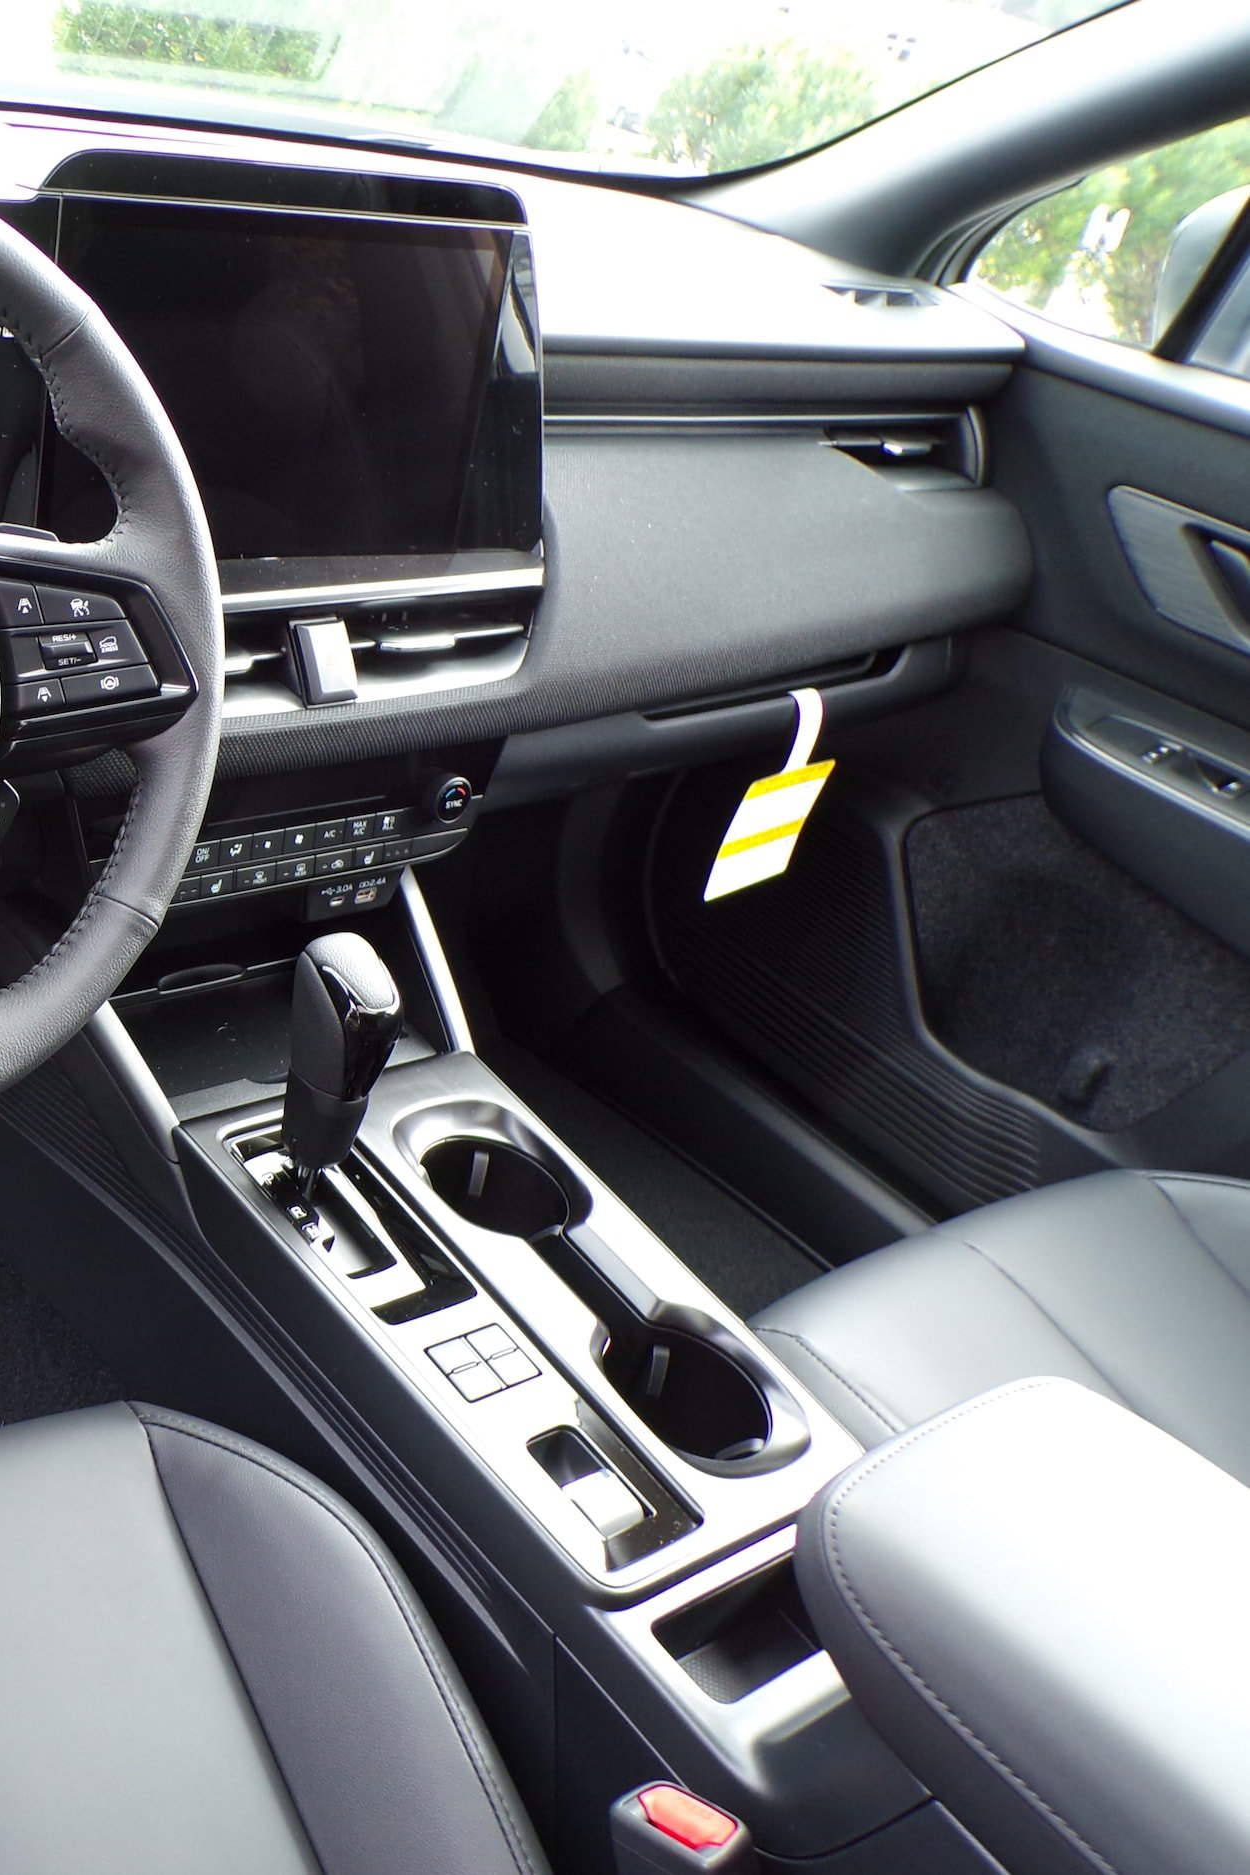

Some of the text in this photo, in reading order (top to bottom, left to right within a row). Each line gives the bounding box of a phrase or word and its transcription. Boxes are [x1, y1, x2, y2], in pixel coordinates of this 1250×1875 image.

[445, 799, 463, 809] SYNC
[352, 820, 368, 829] MAX
[382, 822, 394, 831] ALL
[323, 829, 336, 839] A/C
[353, 828, 365, 836] A/C
[196, 847, 210, 856] ON/
[194, 854, 210, 864] OFF
[291, 1206, 307, 1219] R
